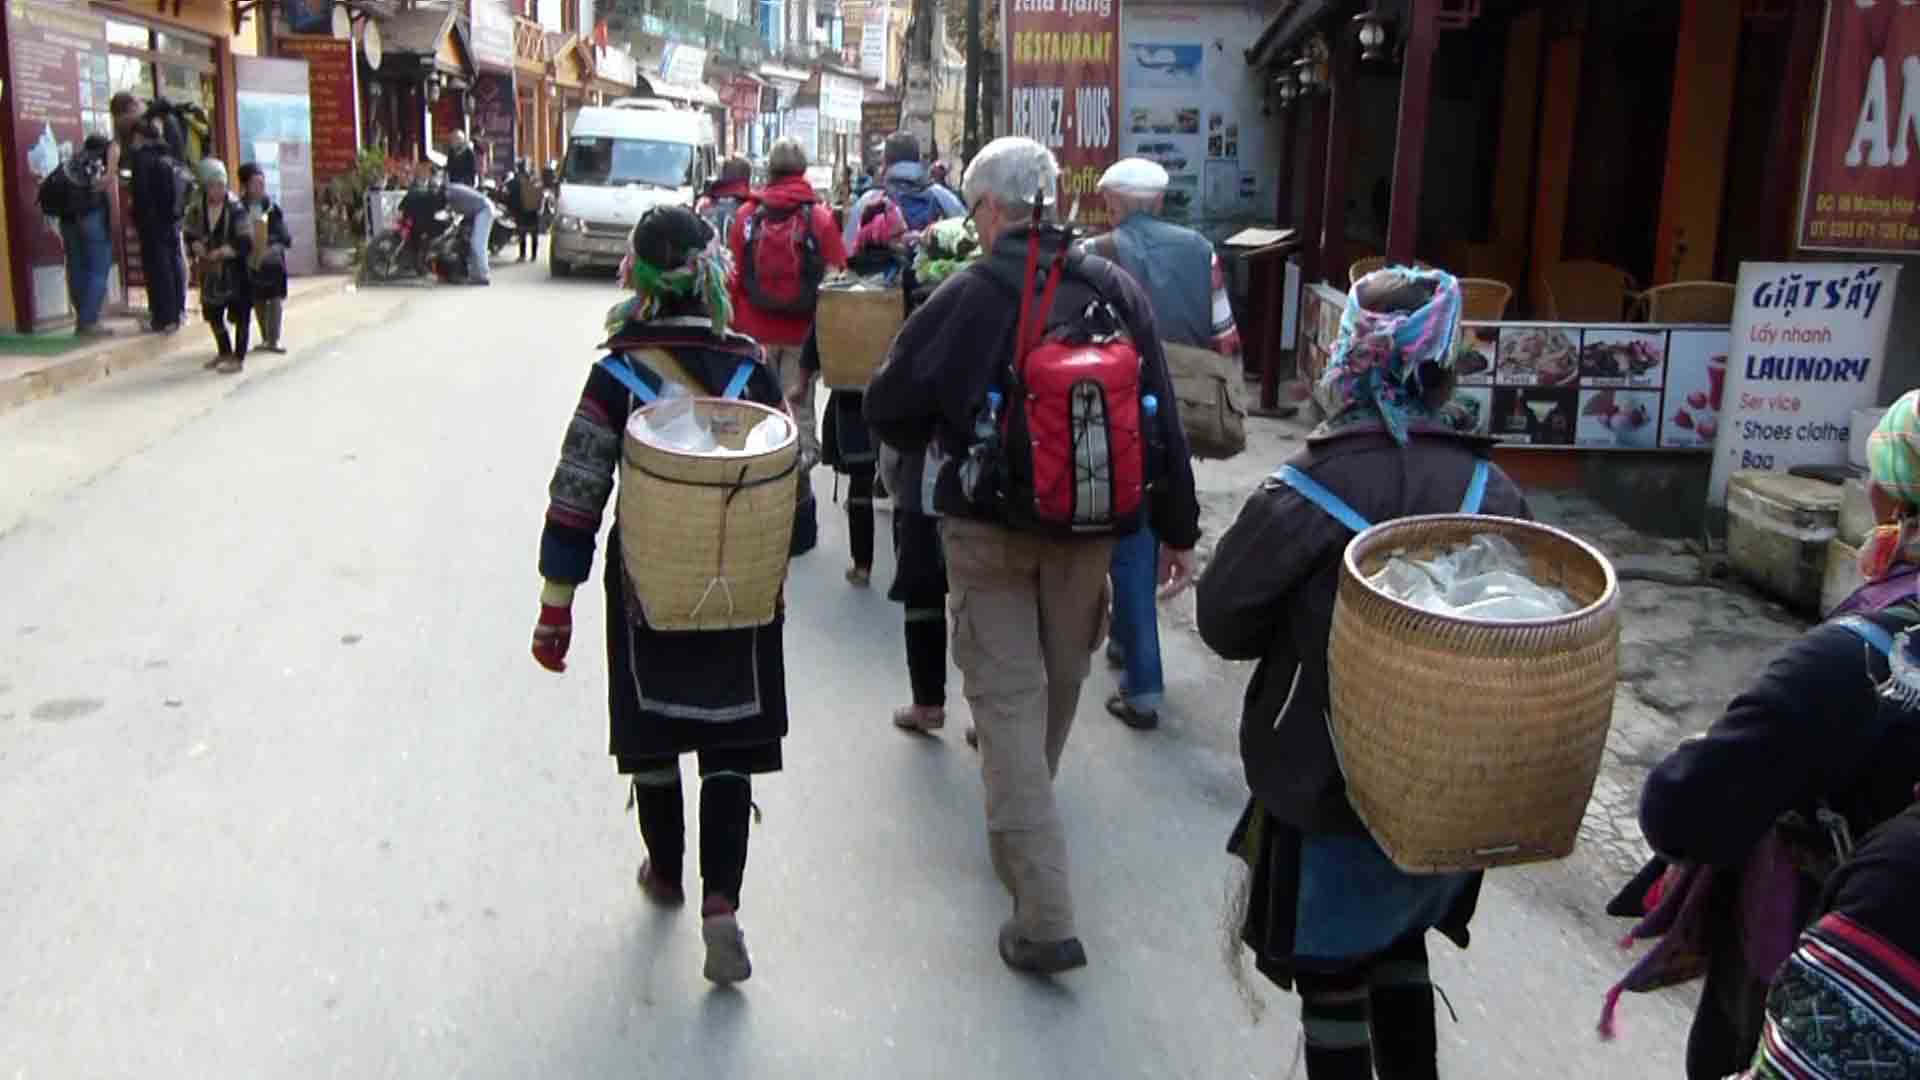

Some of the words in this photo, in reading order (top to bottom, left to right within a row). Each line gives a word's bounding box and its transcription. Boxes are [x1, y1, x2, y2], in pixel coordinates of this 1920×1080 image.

[1013, 31, 1113, 64] RESTAURANT
[1012, 86, 1064, 148] RENDEZ
[1781, 325, 1832, 344] nhanh
[1746, 355, 1871, 382] LAUNDRY
[1742, 419, 1793, 441] Shoes
